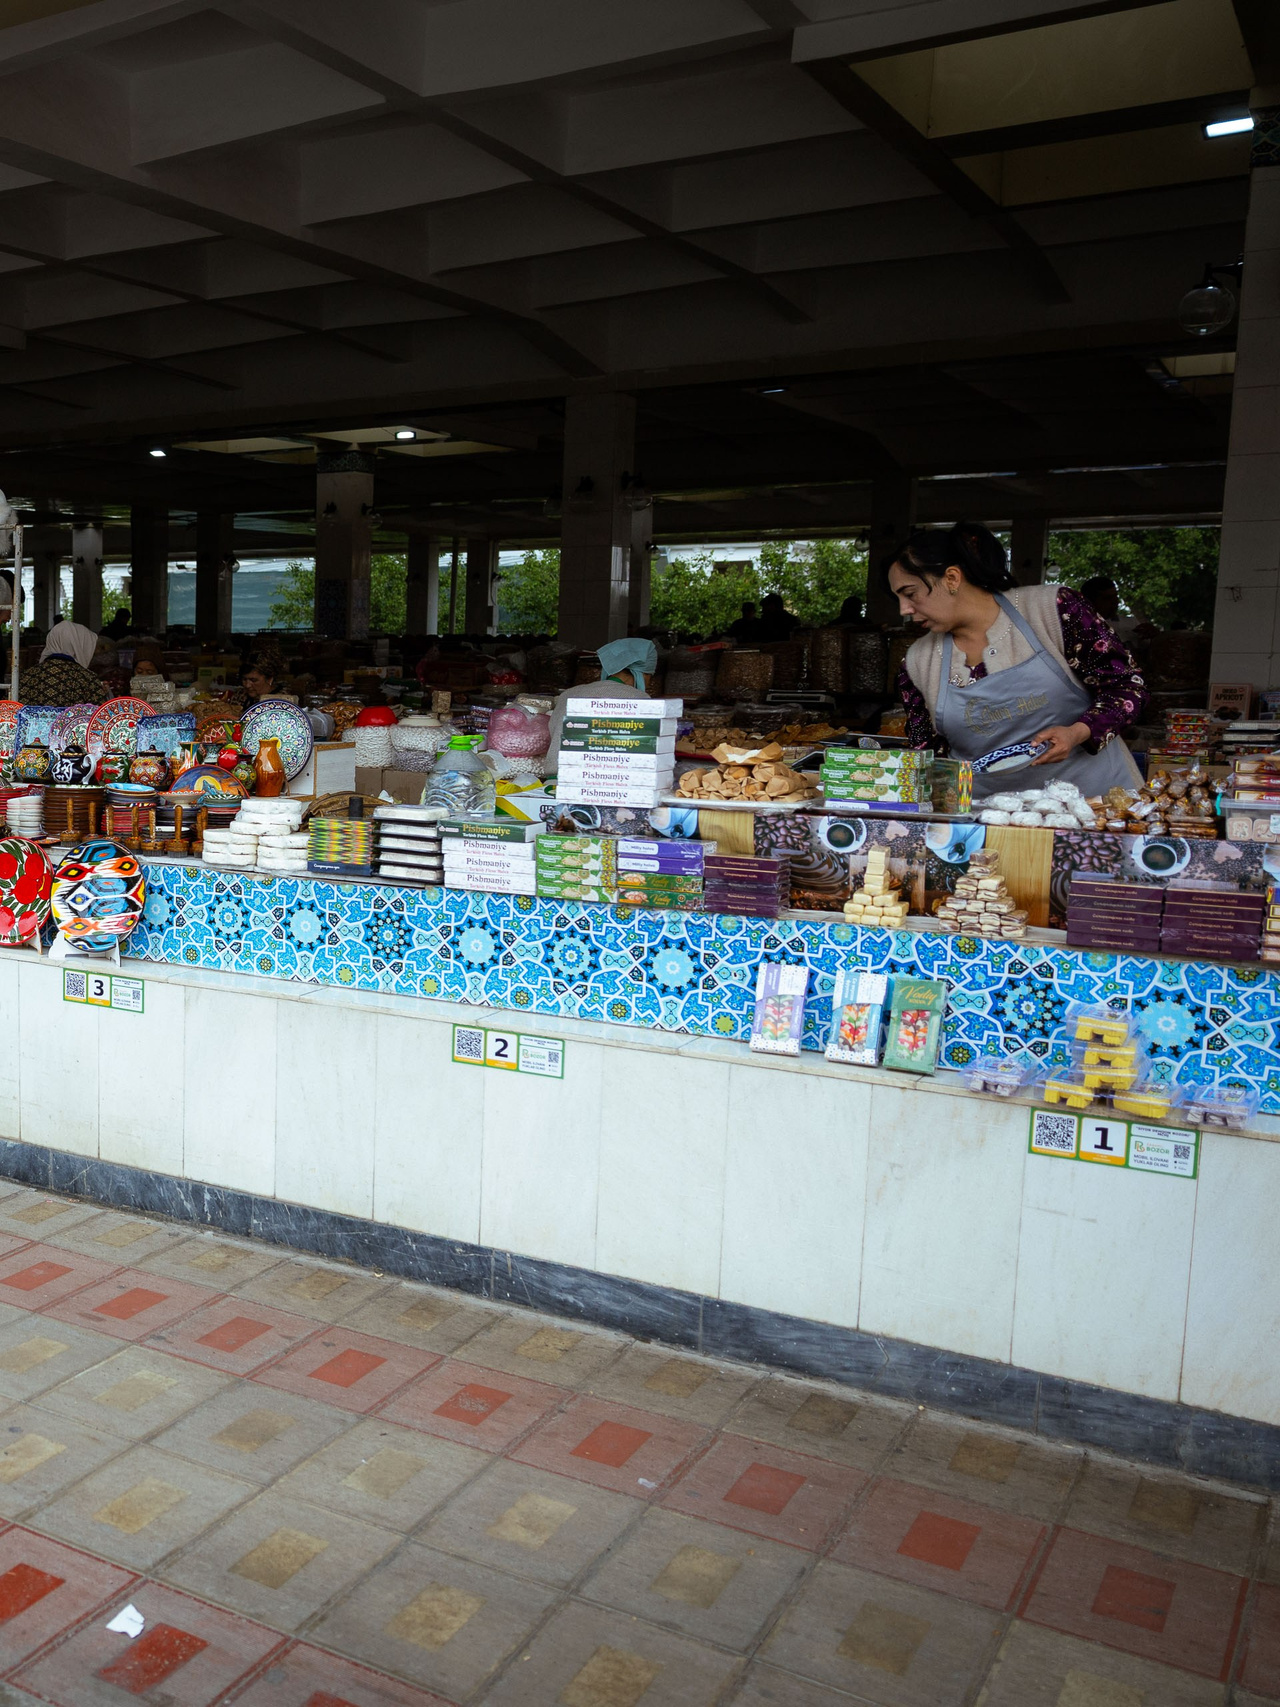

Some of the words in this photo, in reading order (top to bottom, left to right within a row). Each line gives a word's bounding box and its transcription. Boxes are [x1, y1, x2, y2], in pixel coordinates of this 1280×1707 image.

[1215, 693, 1244, 701] APRICOT
[590, 700, 638, 711] Pishmaniye
[591, 719, 644, 729] Pishmaniye
[588, 736, 640, 748] Pishmaniye
[583, 754, 630, 764] Pishmaniye
[582, 771, 630, 782] Pishmaniye
[581, 789, 628, 799] Pishmaniye
[463, 824, 511, 836] Pishmaniye
[464, 840, 506, 851] Pishmaniye
[466, 858, 511, 869] Pishmaniye
[467, 874, 511, 886] Pishmaniye
[94, 979, 104, 996] 3
[900, 986, 938, 1006] Vodiy
[495, 1038, 508, 1058] 2
[1094, 1127, 1113, 1151] 1
